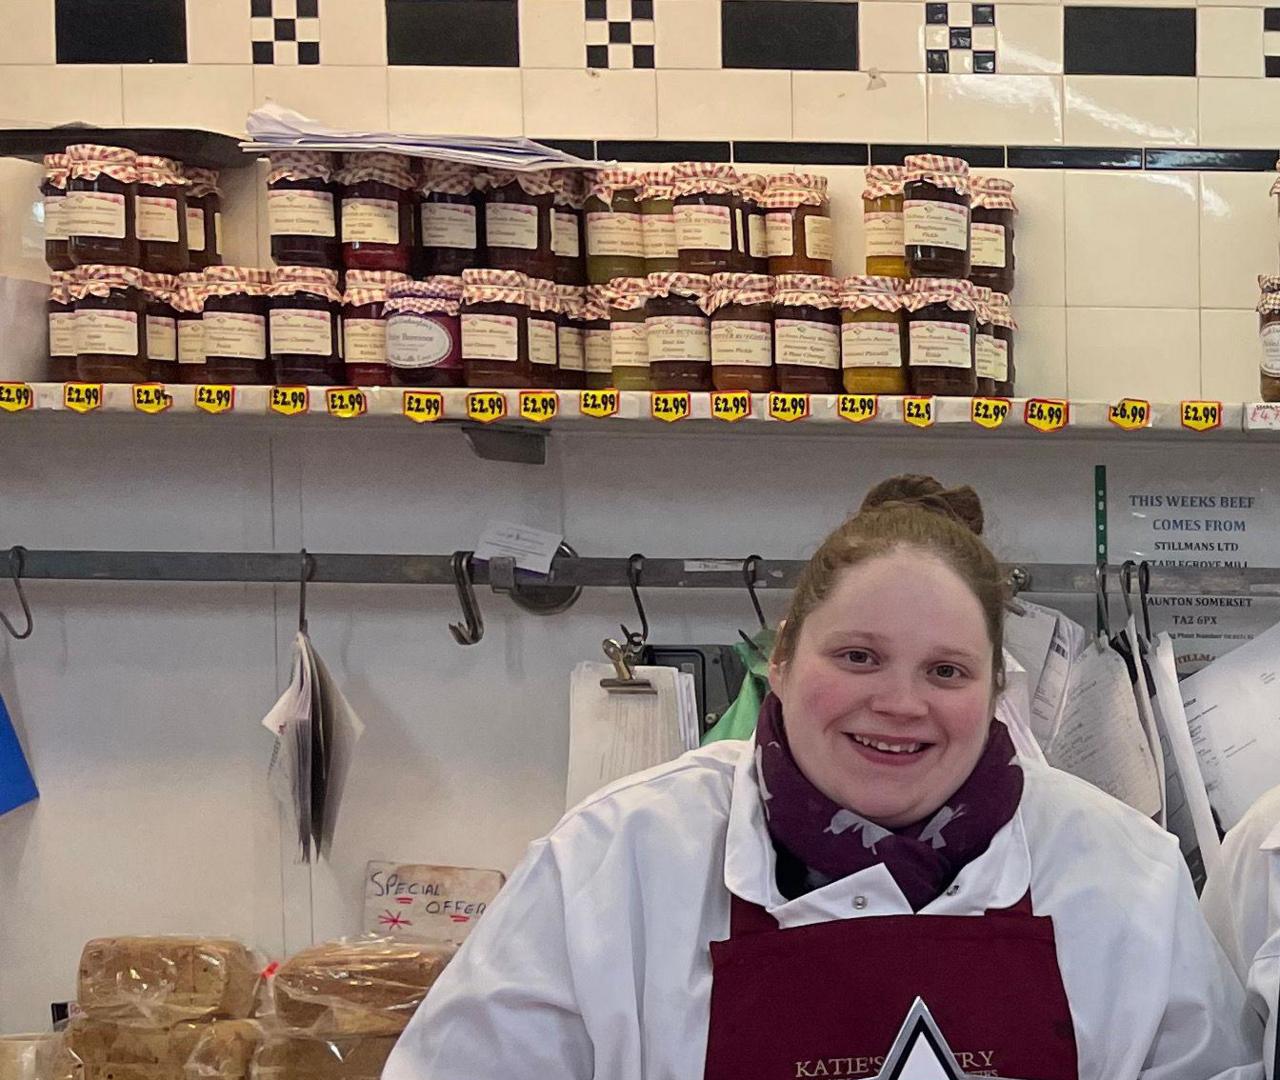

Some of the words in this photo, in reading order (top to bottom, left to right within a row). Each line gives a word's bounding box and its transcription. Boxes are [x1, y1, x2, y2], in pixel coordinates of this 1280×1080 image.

[67, 386, 99, 407] £2.99
[199, 386, 230, 407] £2.99
[273, 387, 305, 408] £2.99
[331, 392, 362, 412] £2.99
[407, 396, 439, 415] £2.99
[471, 396, 502, 415] £2.99
[523, 396, 555, 415] £2.99
[583, 392, 615, 411] £2.99
[655, 396, 687, 415] £2.99
[715, 397, 747, 415] £2.99
[773, 396, 805, 415] £2.99
[842, 397, 874, 415] £2.99
[975, 401, 1007, 419] £2.99
[1029, 403, 1065, 425] £6.99
[1111, 404, 1146, 424] £6.99
[1185, 405, 1217, 424] £2.99
[1129, 495, 1162, 507] THIS
[1166, 495, 1216, 508] WEEKS
[1220, 496, 1256, 509] BEEF
[1152, 519, 1201, 531] COMES
[1205, 520, 1246, 532] FROM
[1154, 541, 1215, 552] STILLMANS
[1217, 541, 1239, 552] LTD
[1194, 598, 1253, 608] SOMERSET
[1172, 616, 1194, 625] TA2
[371, 872, 440, 896] SPECIAL
[795, 1056, 884, 1078] KATIE'S
